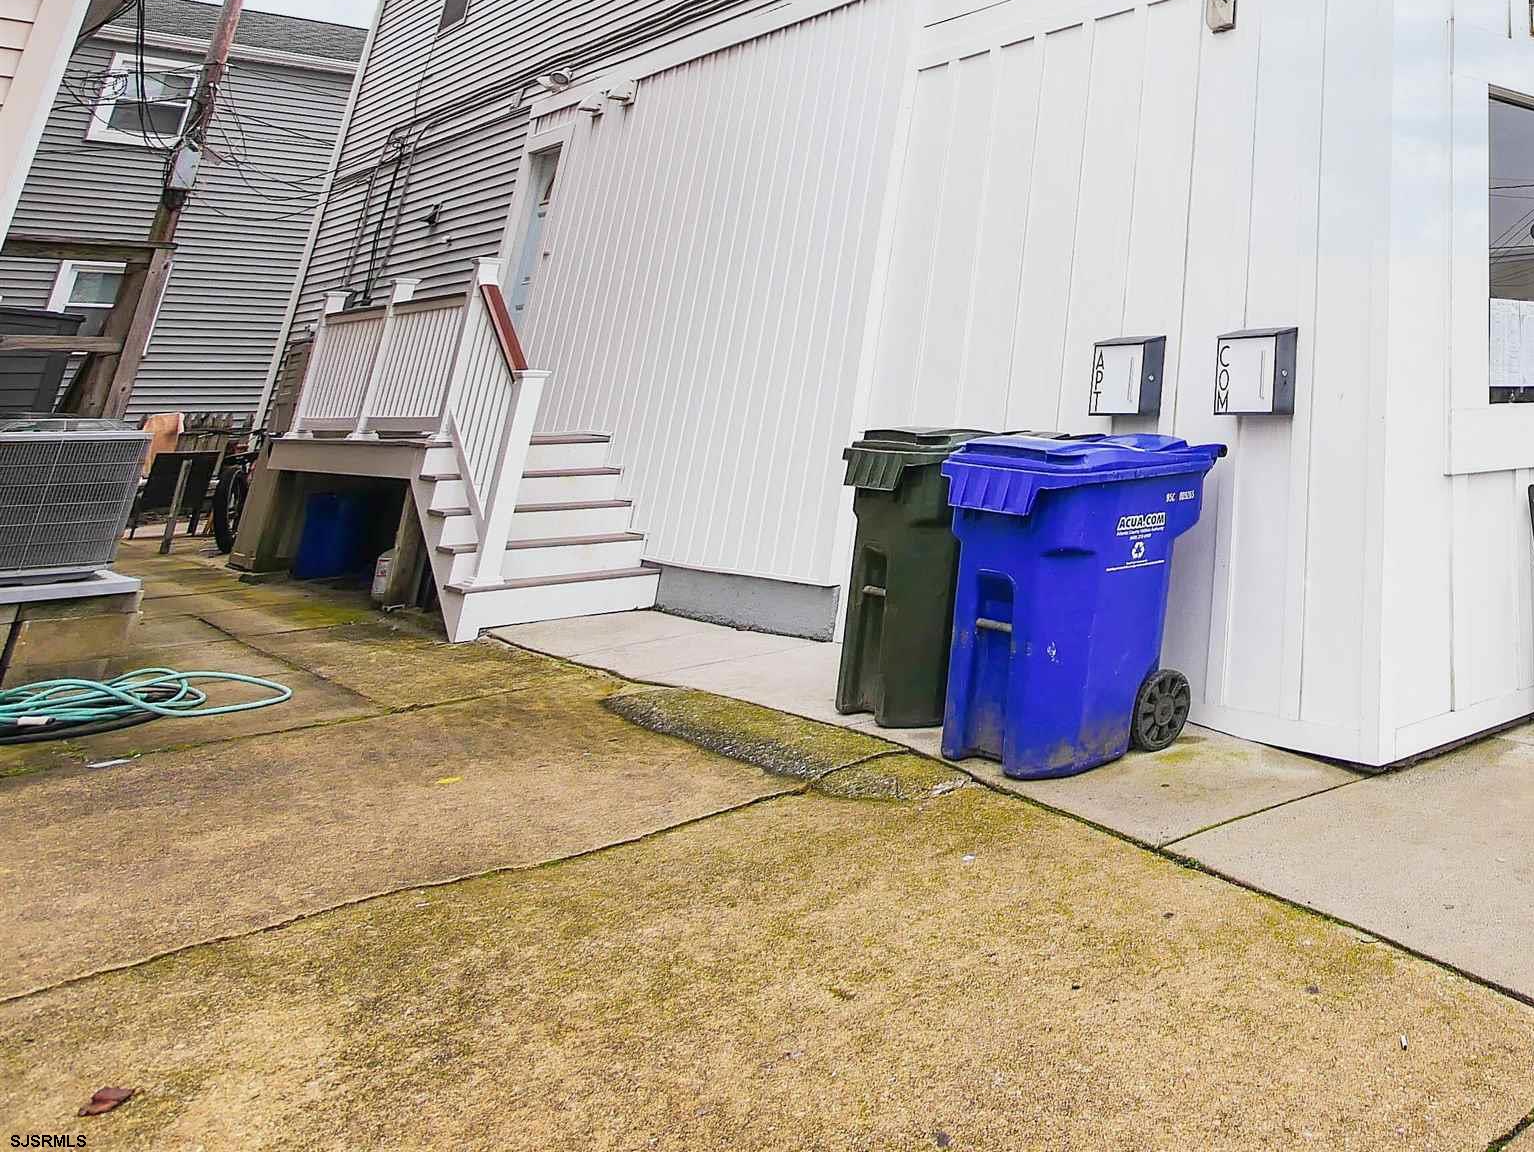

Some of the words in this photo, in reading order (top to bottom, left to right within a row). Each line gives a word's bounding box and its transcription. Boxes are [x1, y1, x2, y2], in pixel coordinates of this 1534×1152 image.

[1092, 350, 1105, 412] APT
[1216, 345, 1231, 413] COM
[1118, 513, 1165, 529] ACUA.COM
